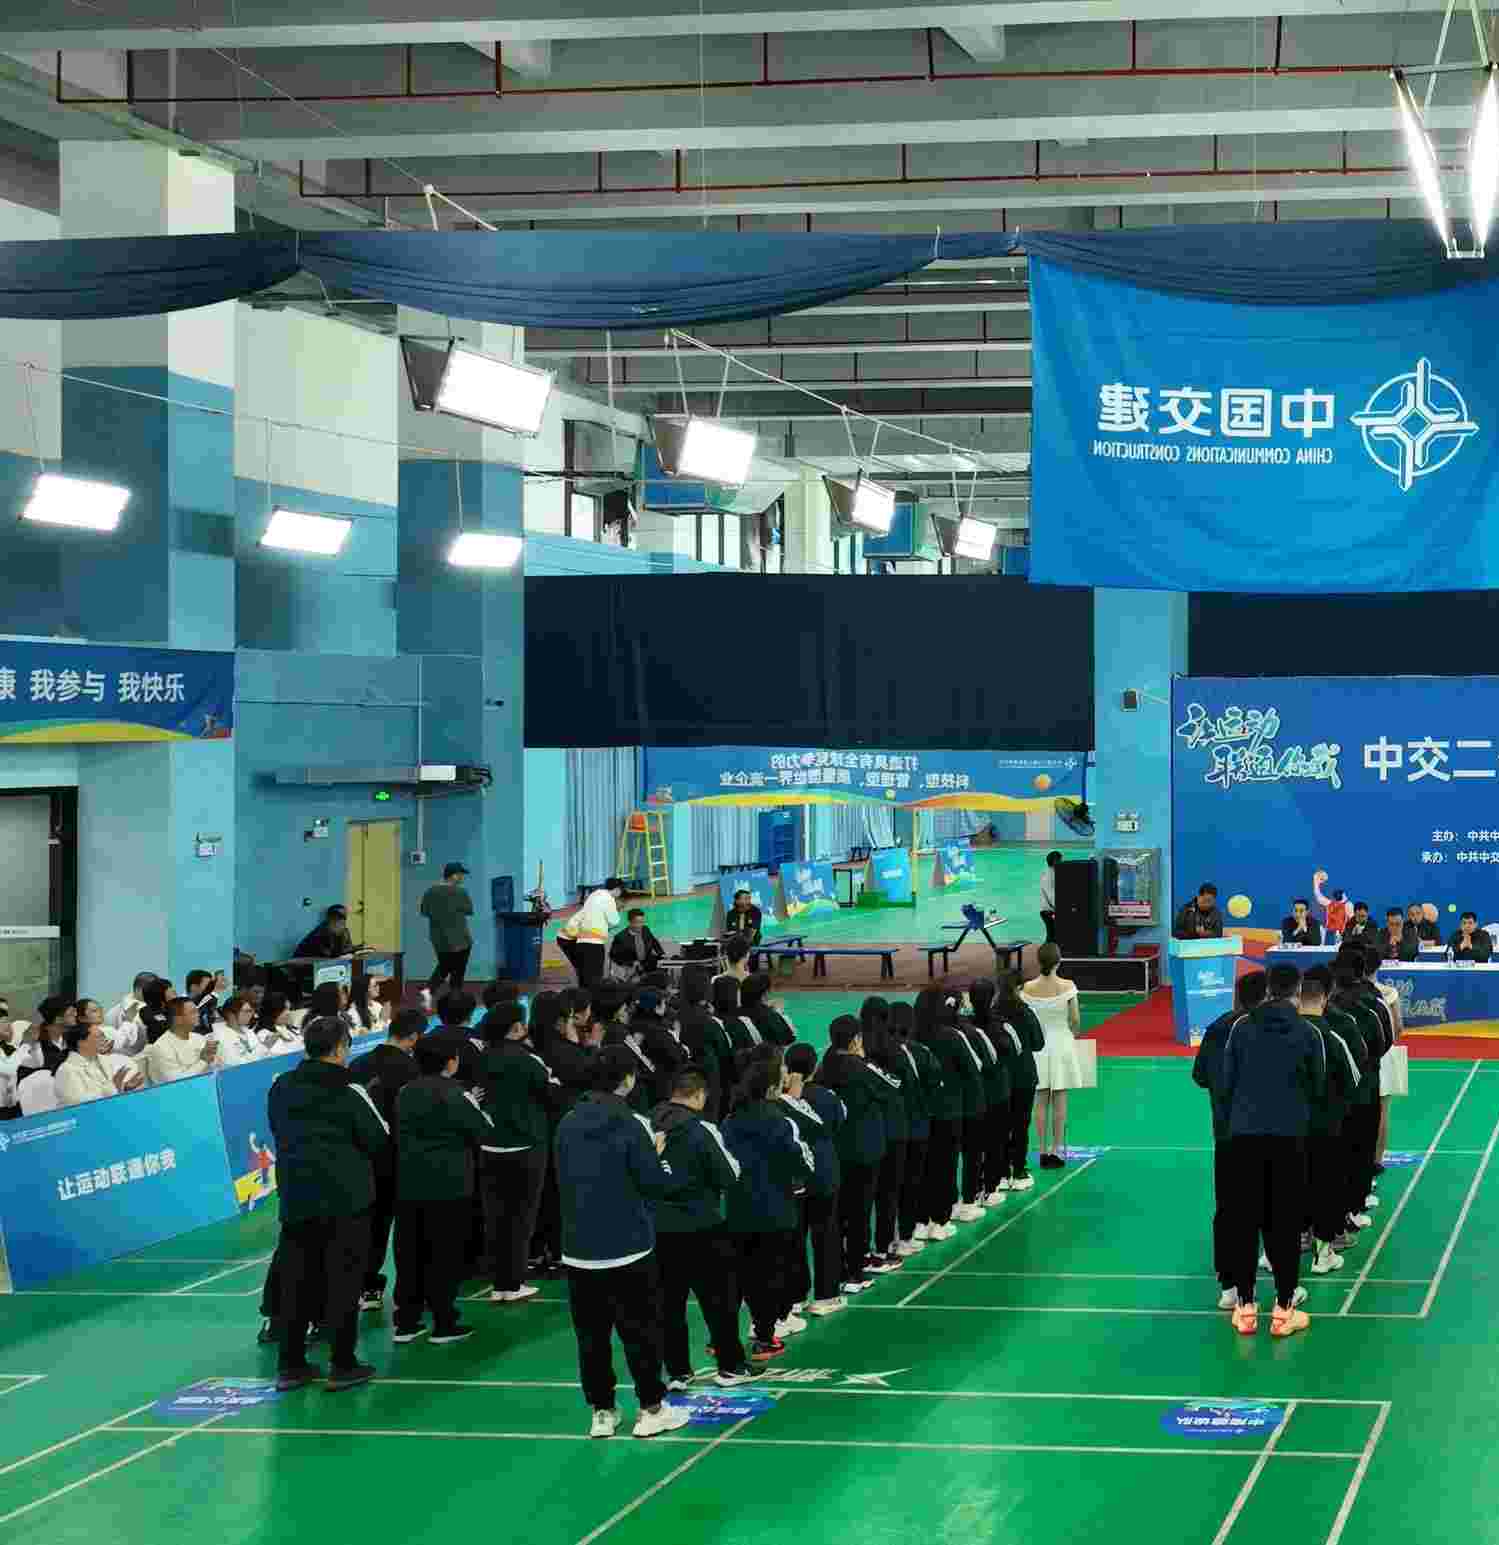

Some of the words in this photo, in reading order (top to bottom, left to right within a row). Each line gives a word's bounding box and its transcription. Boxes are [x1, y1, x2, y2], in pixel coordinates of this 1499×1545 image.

[30, 669, 106, 702] 我参与
[118, 672, 185, 703] 我快乐
